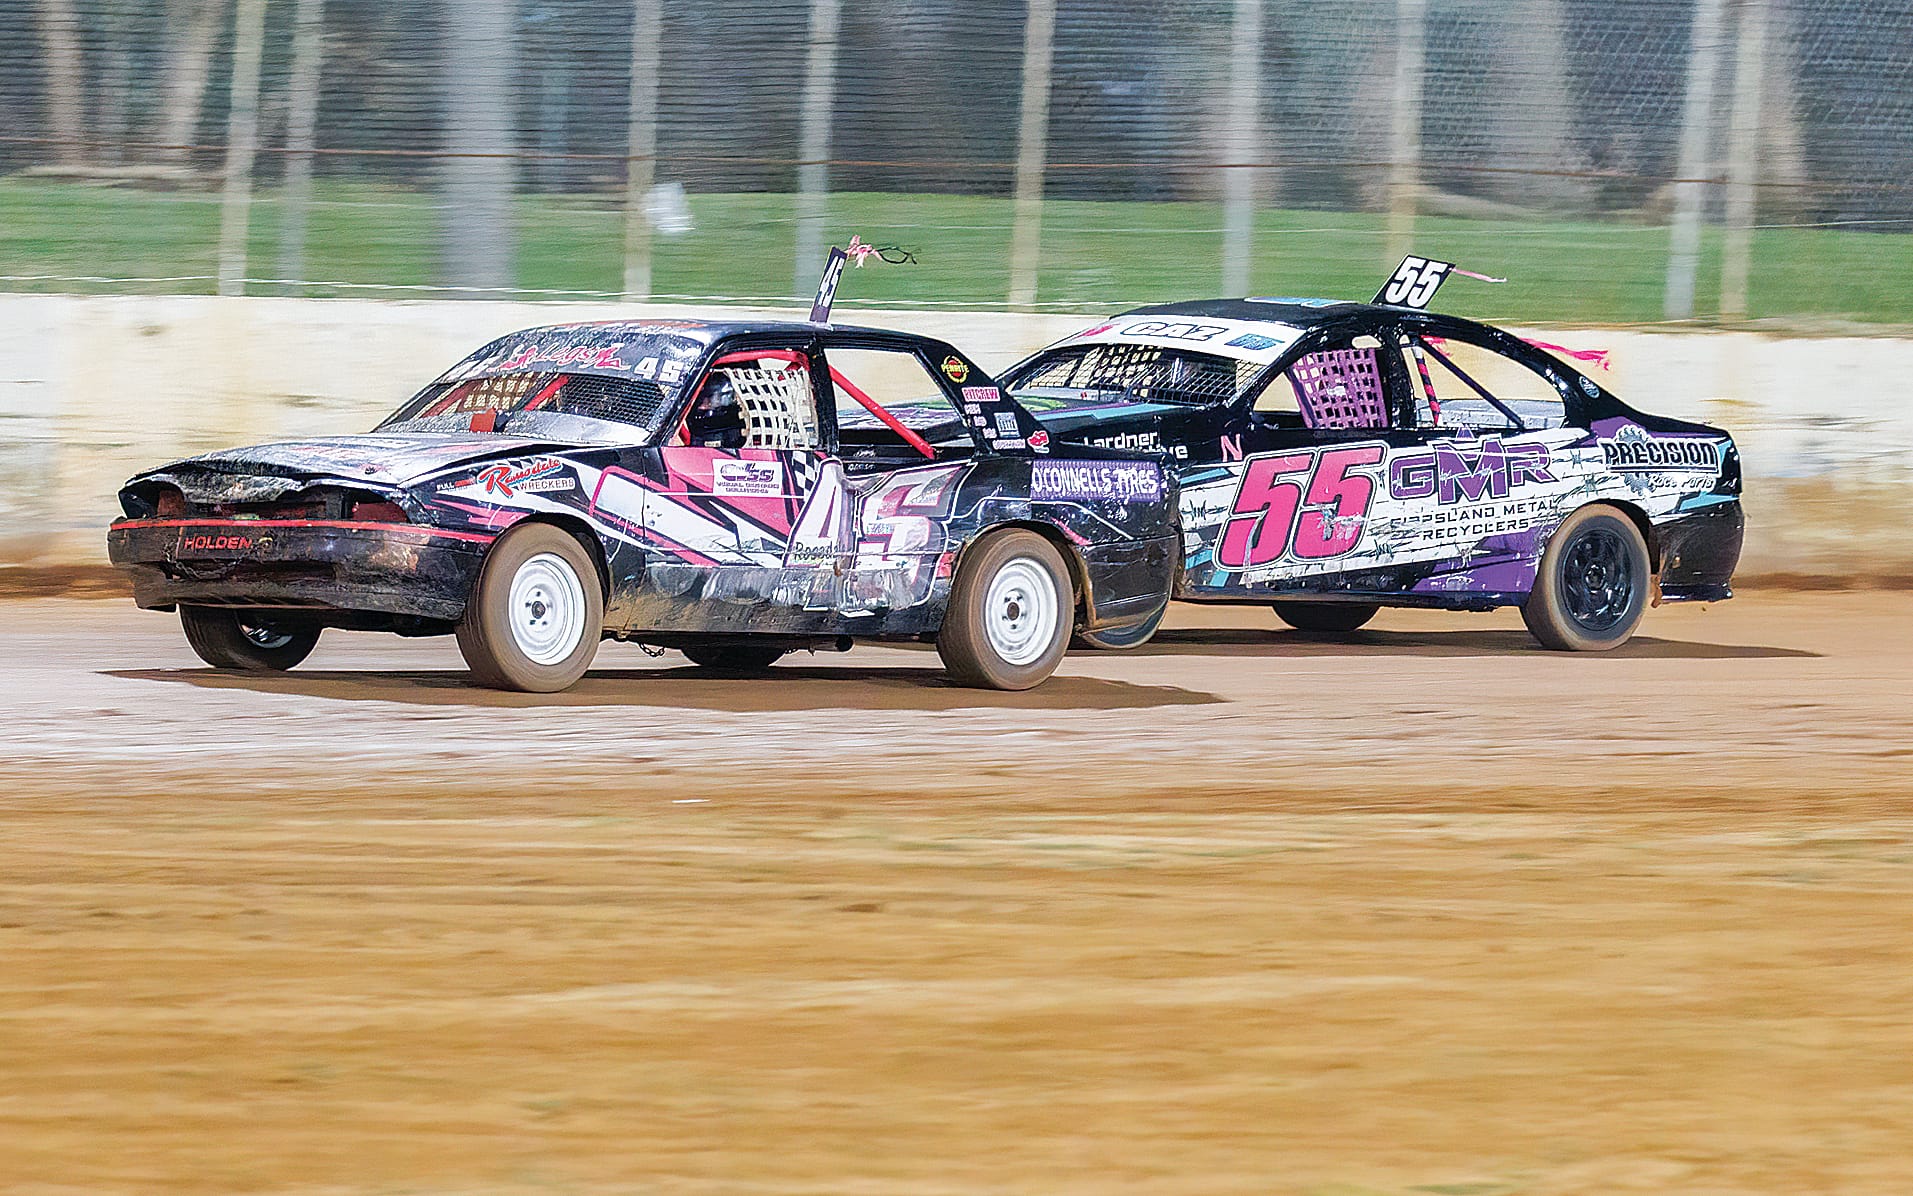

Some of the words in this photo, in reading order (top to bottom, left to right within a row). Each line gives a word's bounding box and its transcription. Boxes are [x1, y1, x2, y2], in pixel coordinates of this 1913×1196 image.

[817, 255, 845, 308] 45
[1385, 256, 1448, 308] 55
[634, 356, 685, 383] 45
[1220, 433, 1243, 462] N
[1602, 442, 1718, 465] PRECISION
[519, 478, 575, 491] WRECKERS
[1031, 467, 1112, 494] O'CONNELLS
[1113, 467, 1158, 494] TYRES
[1390, 437, 1560, 505] GMR
[1216, 443, 1386, 571] 55
[1504, 500, 1558, 516] METAL
[184, 535, 253, 550] HOLDEN
[1422, 518, 1530, 541] RECYCLERS
